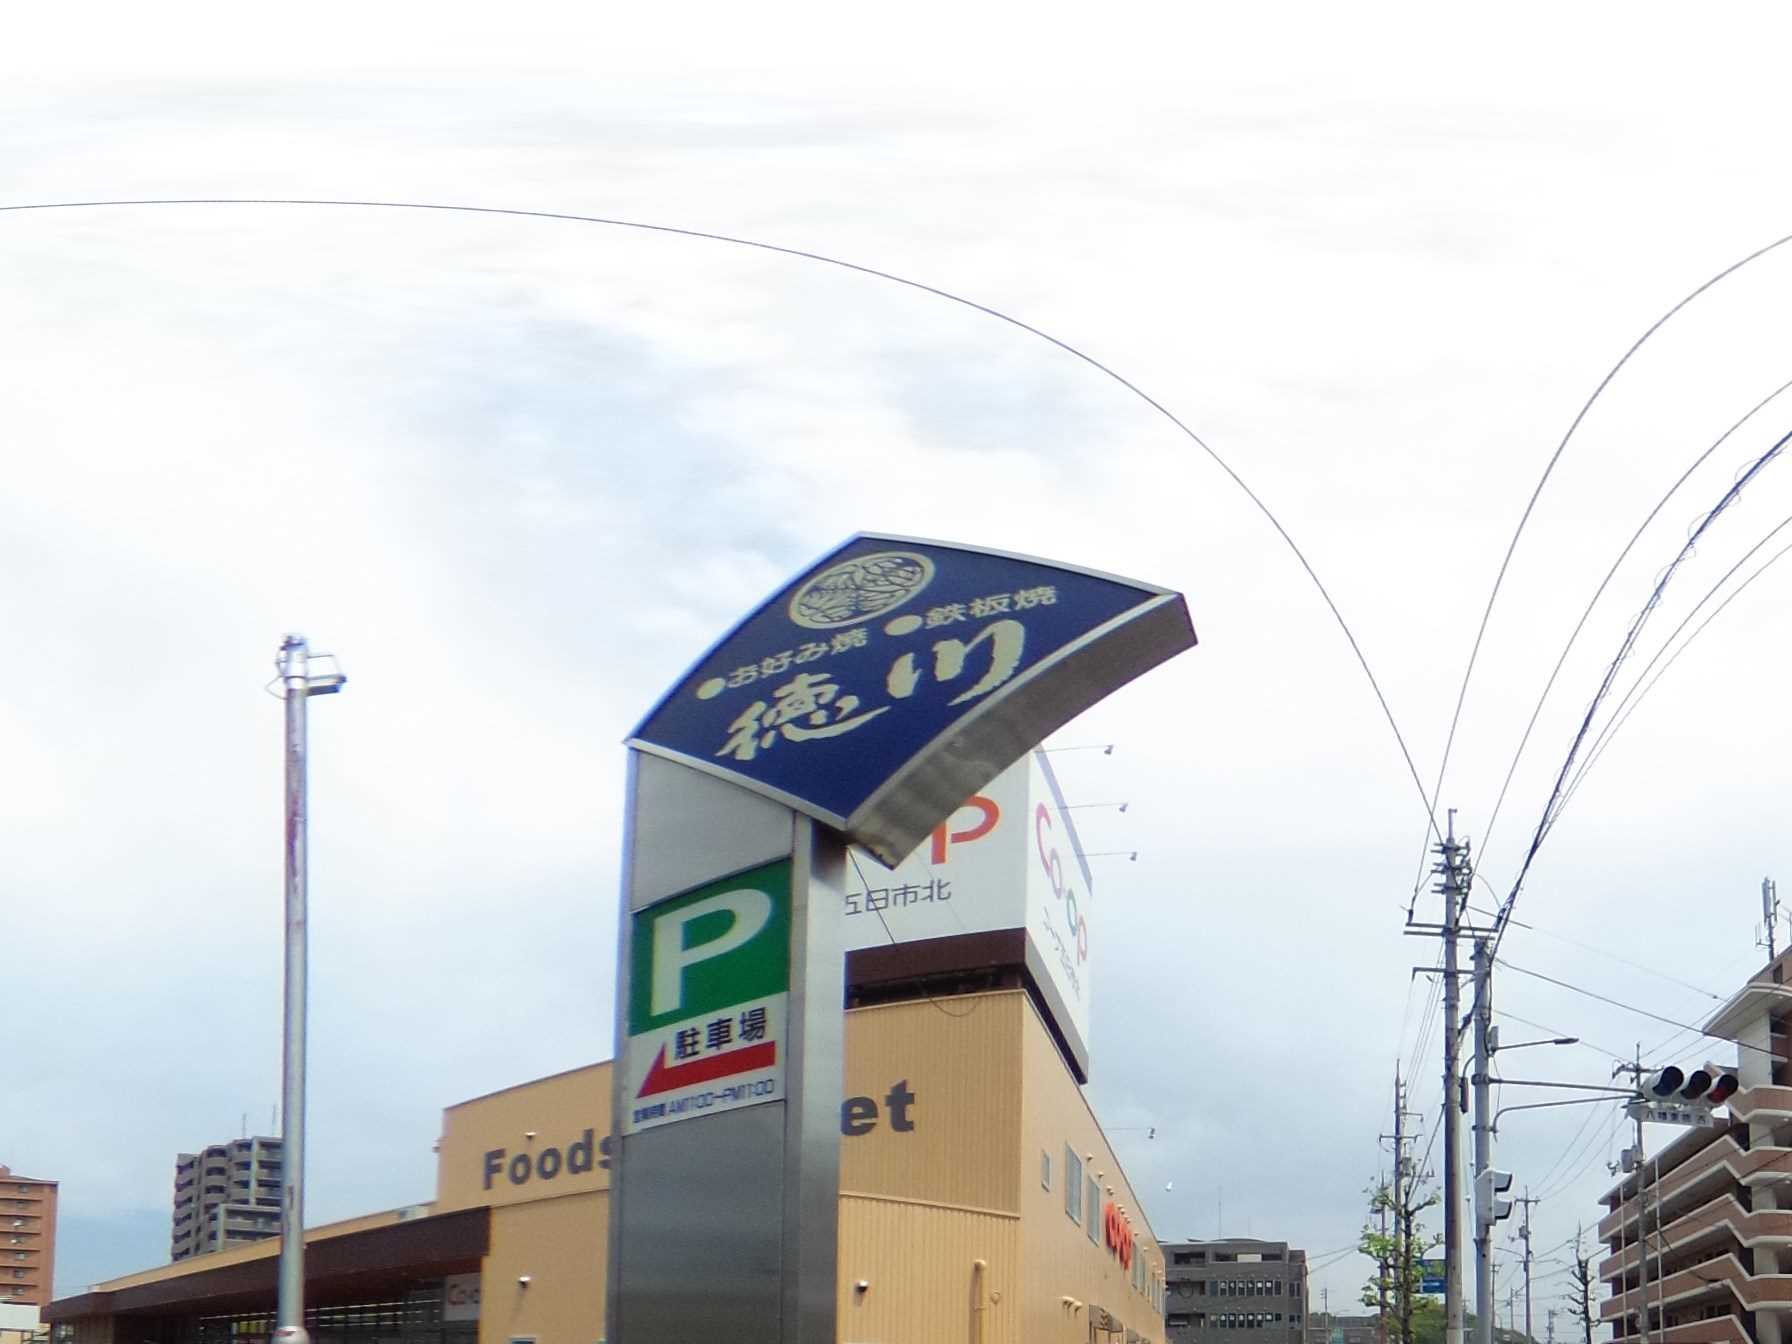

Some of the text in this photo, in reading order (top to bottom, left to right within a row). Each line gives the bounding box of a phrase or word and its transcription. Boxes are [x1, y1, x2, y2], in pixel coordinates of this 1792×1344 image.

[926, 585, 1058, 629] 鉄板焼
[727, 626, 869, 689] お好み焼
[715, 618, 1025, 761] 徳川
[650, 888, 772, 1017] P
[674, 1006, 767, 1060] 駐車場
